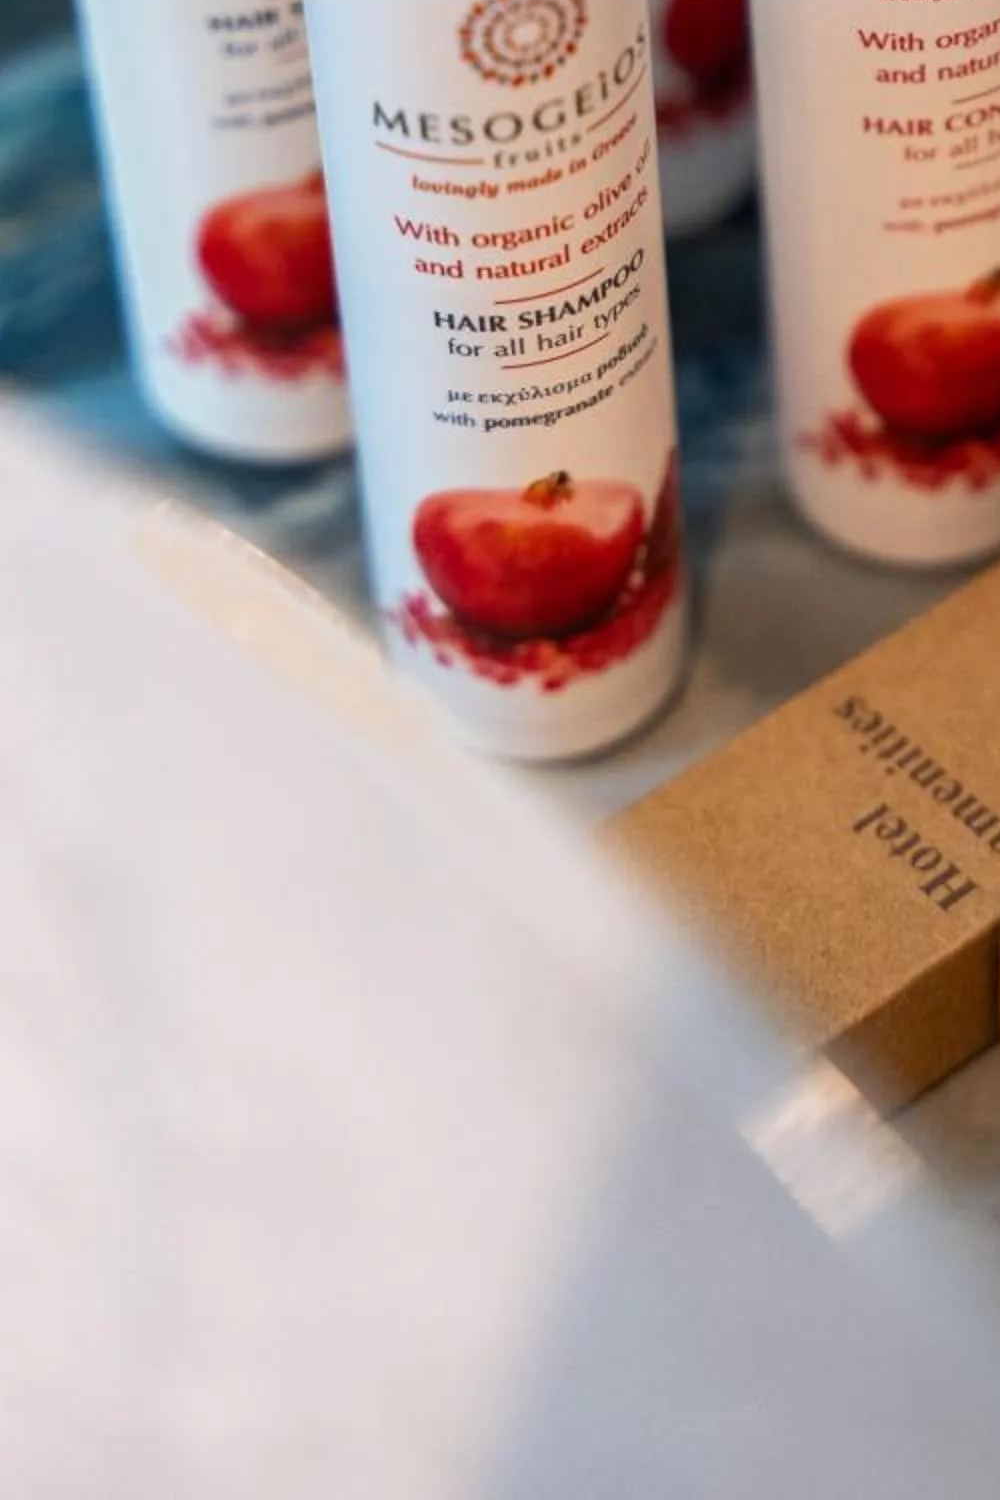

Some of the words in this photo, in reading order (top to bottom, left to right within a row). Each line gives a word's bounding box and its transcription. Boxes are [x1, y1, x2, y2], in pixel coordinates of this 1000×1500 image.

[857, 28, 925, 52] With
[875, 65, 926, 84] and
[492, 132, 582, 169] fruits
[862, 115, 934, 137] HAIR
[411, 175, 498, 199] lovingly
[506, 165, 563, 193] made
[569, 156, 588, 175] in
[393, 215, 461, 247] With
[471, 210, 574, 251] organic
[583, 172, 632, 219] olive
[414, 257, 464, 280] and
[476, 246, 571, 281] natural
[580, 184, 648, 256] extracts
[432, 310, 508, 333] HAIR
[518, 247, 646, 330] SHAMPOO
[447, 338, 484, 358] for
[493, 335, 526, 357] all
[537, 322, 585, 352] hair
[593, 283, 641, 332] types
[432, 410, 477, 428] with
[484, 383, 614, 433] pomegranate
[852, 801, 981, 912] Hotel
